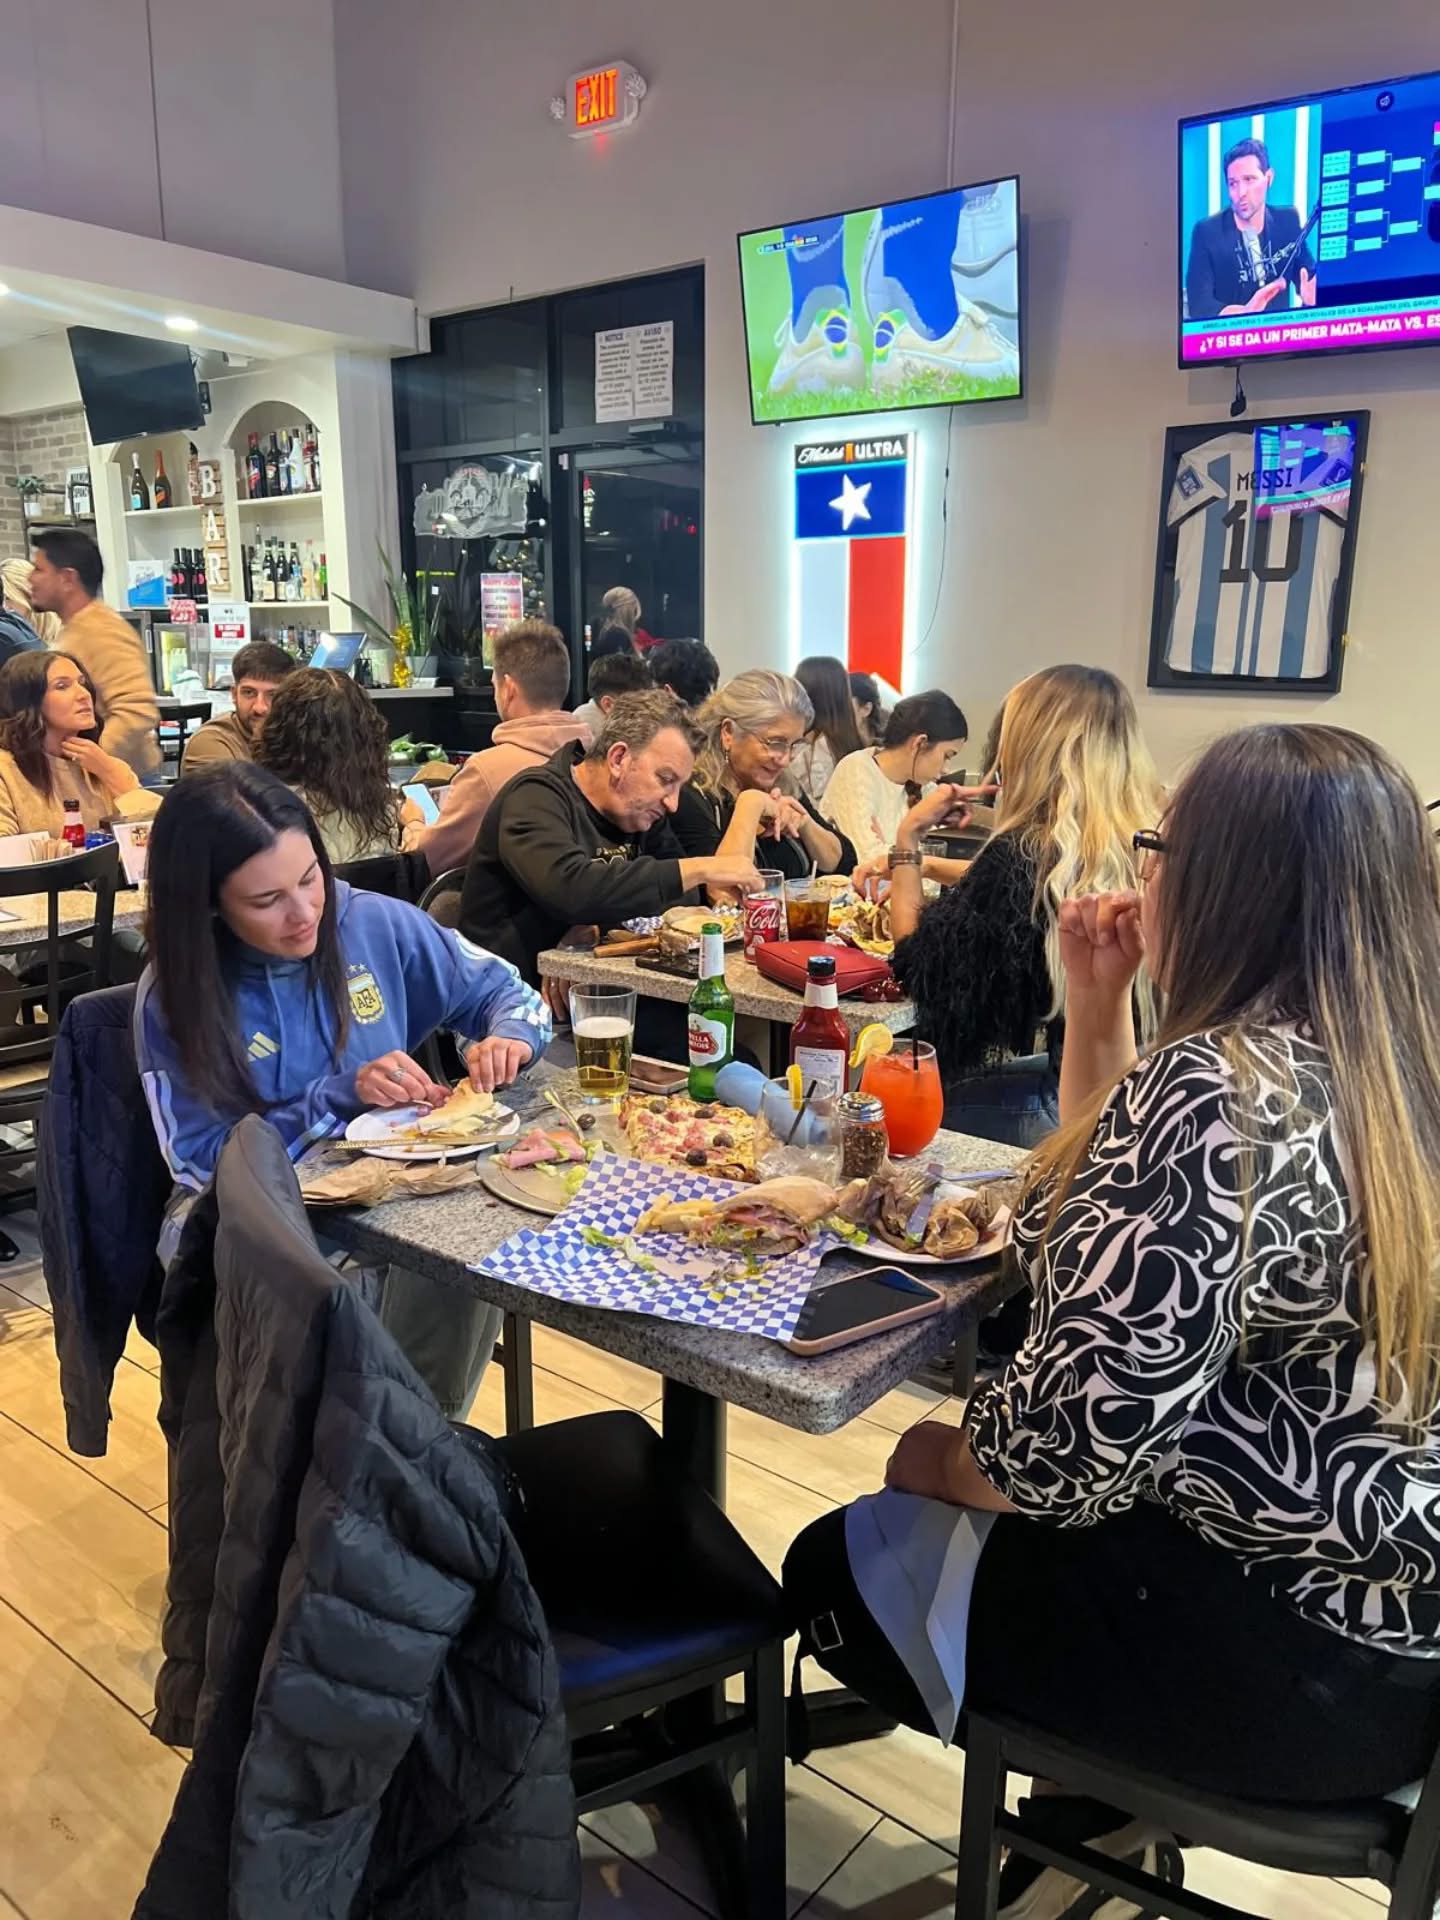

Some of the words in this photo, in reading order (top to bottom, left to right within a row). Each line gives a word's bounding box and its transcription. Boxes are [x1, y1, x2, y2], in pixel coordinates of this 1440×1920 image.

[576, 68, 618, 125] EXIT
[1200, 336, 1215, 353] ¿Y
[1216, 335, 1227, 349] SI
[1228, 333, 1243, 347] SE
[1245, 331, 1261, 346] DA
[1262, 330, 1281, 344] UN
[1282, 324, 1328, 342] PRIMER
[1330, 318, 1402, 337] MATA-MATA
[1404, 315, 1425, 330] VS.
[855, 440, 904, 459] ULTRA
[1237, 468, 1293, 492] MESSI
[1219, 499, 1303, 583] 10
